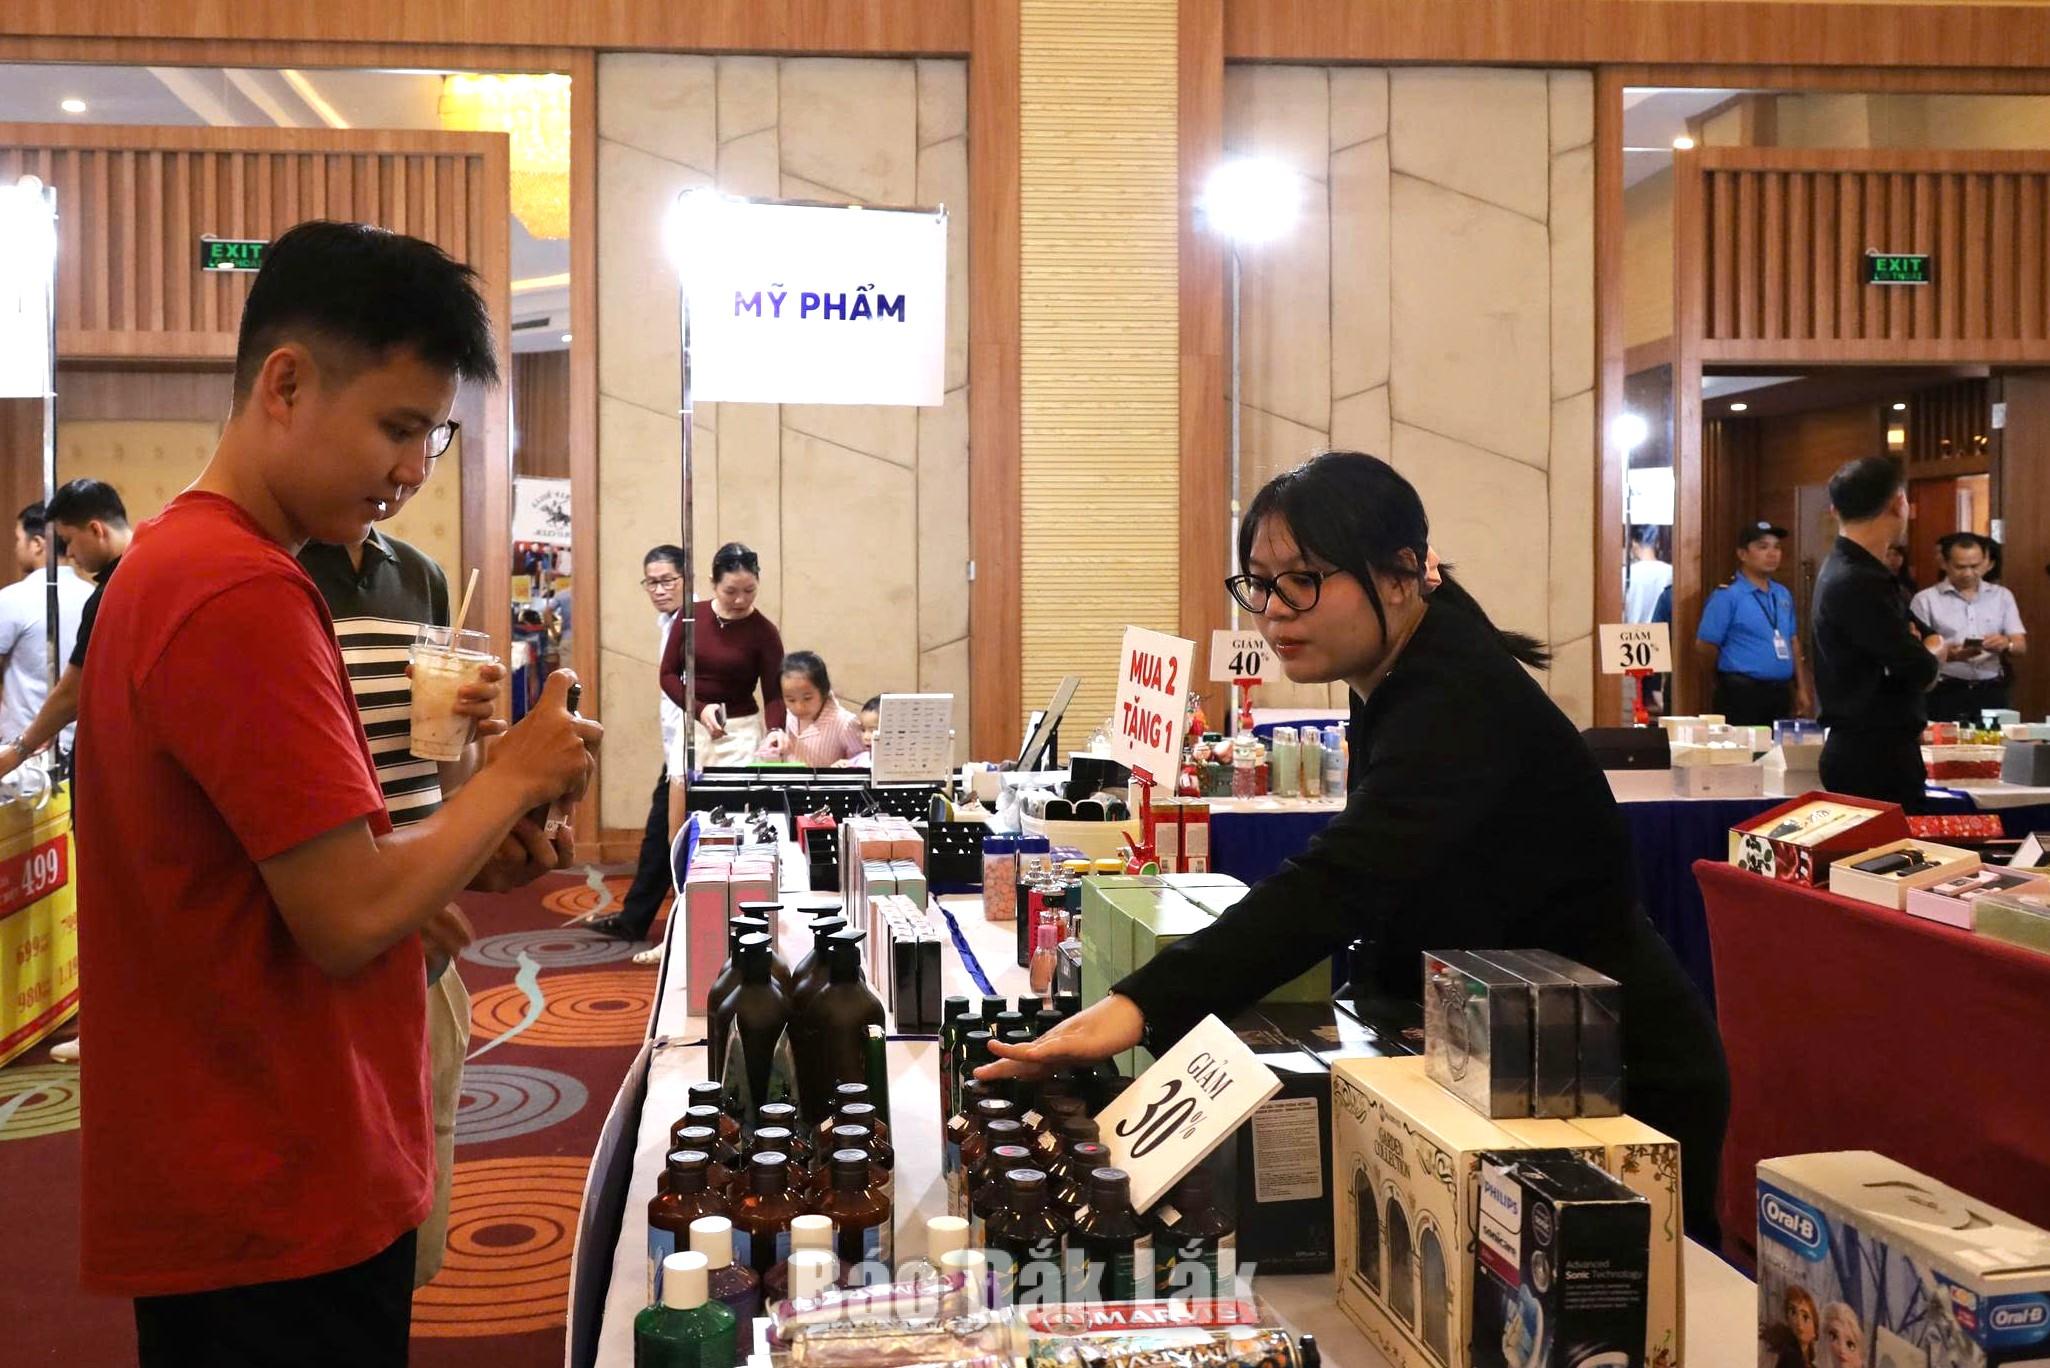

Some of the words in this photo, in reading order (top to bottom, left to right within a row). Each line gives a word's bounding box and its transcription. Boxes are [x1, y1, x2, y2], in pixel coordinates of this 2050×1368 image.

[211, 243, 263, 258] EXIT
[1876, 258, 1922, 272] EXIT
[734, 282, 788, 318] MỸ
[800, 283, 906, 323] PHẨM
[1129, 649, 1162, 692] MUA
[1164, 655, 1179, 697] 2
[1122, 695, 1163, 750] TẶNG
[1164, 719, 1174, 754] 1
[21, 847, 59, 897] 499
[1186, 1051, 1235, 1101] GIẢM
[1115, 1078, 1208, 1159] 30%
[1484, 1180, 1519, 1216] PHILIPS
[1766, 1200, 1814, 1240] Oral-B
[1995, 1306, 2044, 1326] Oral-B
